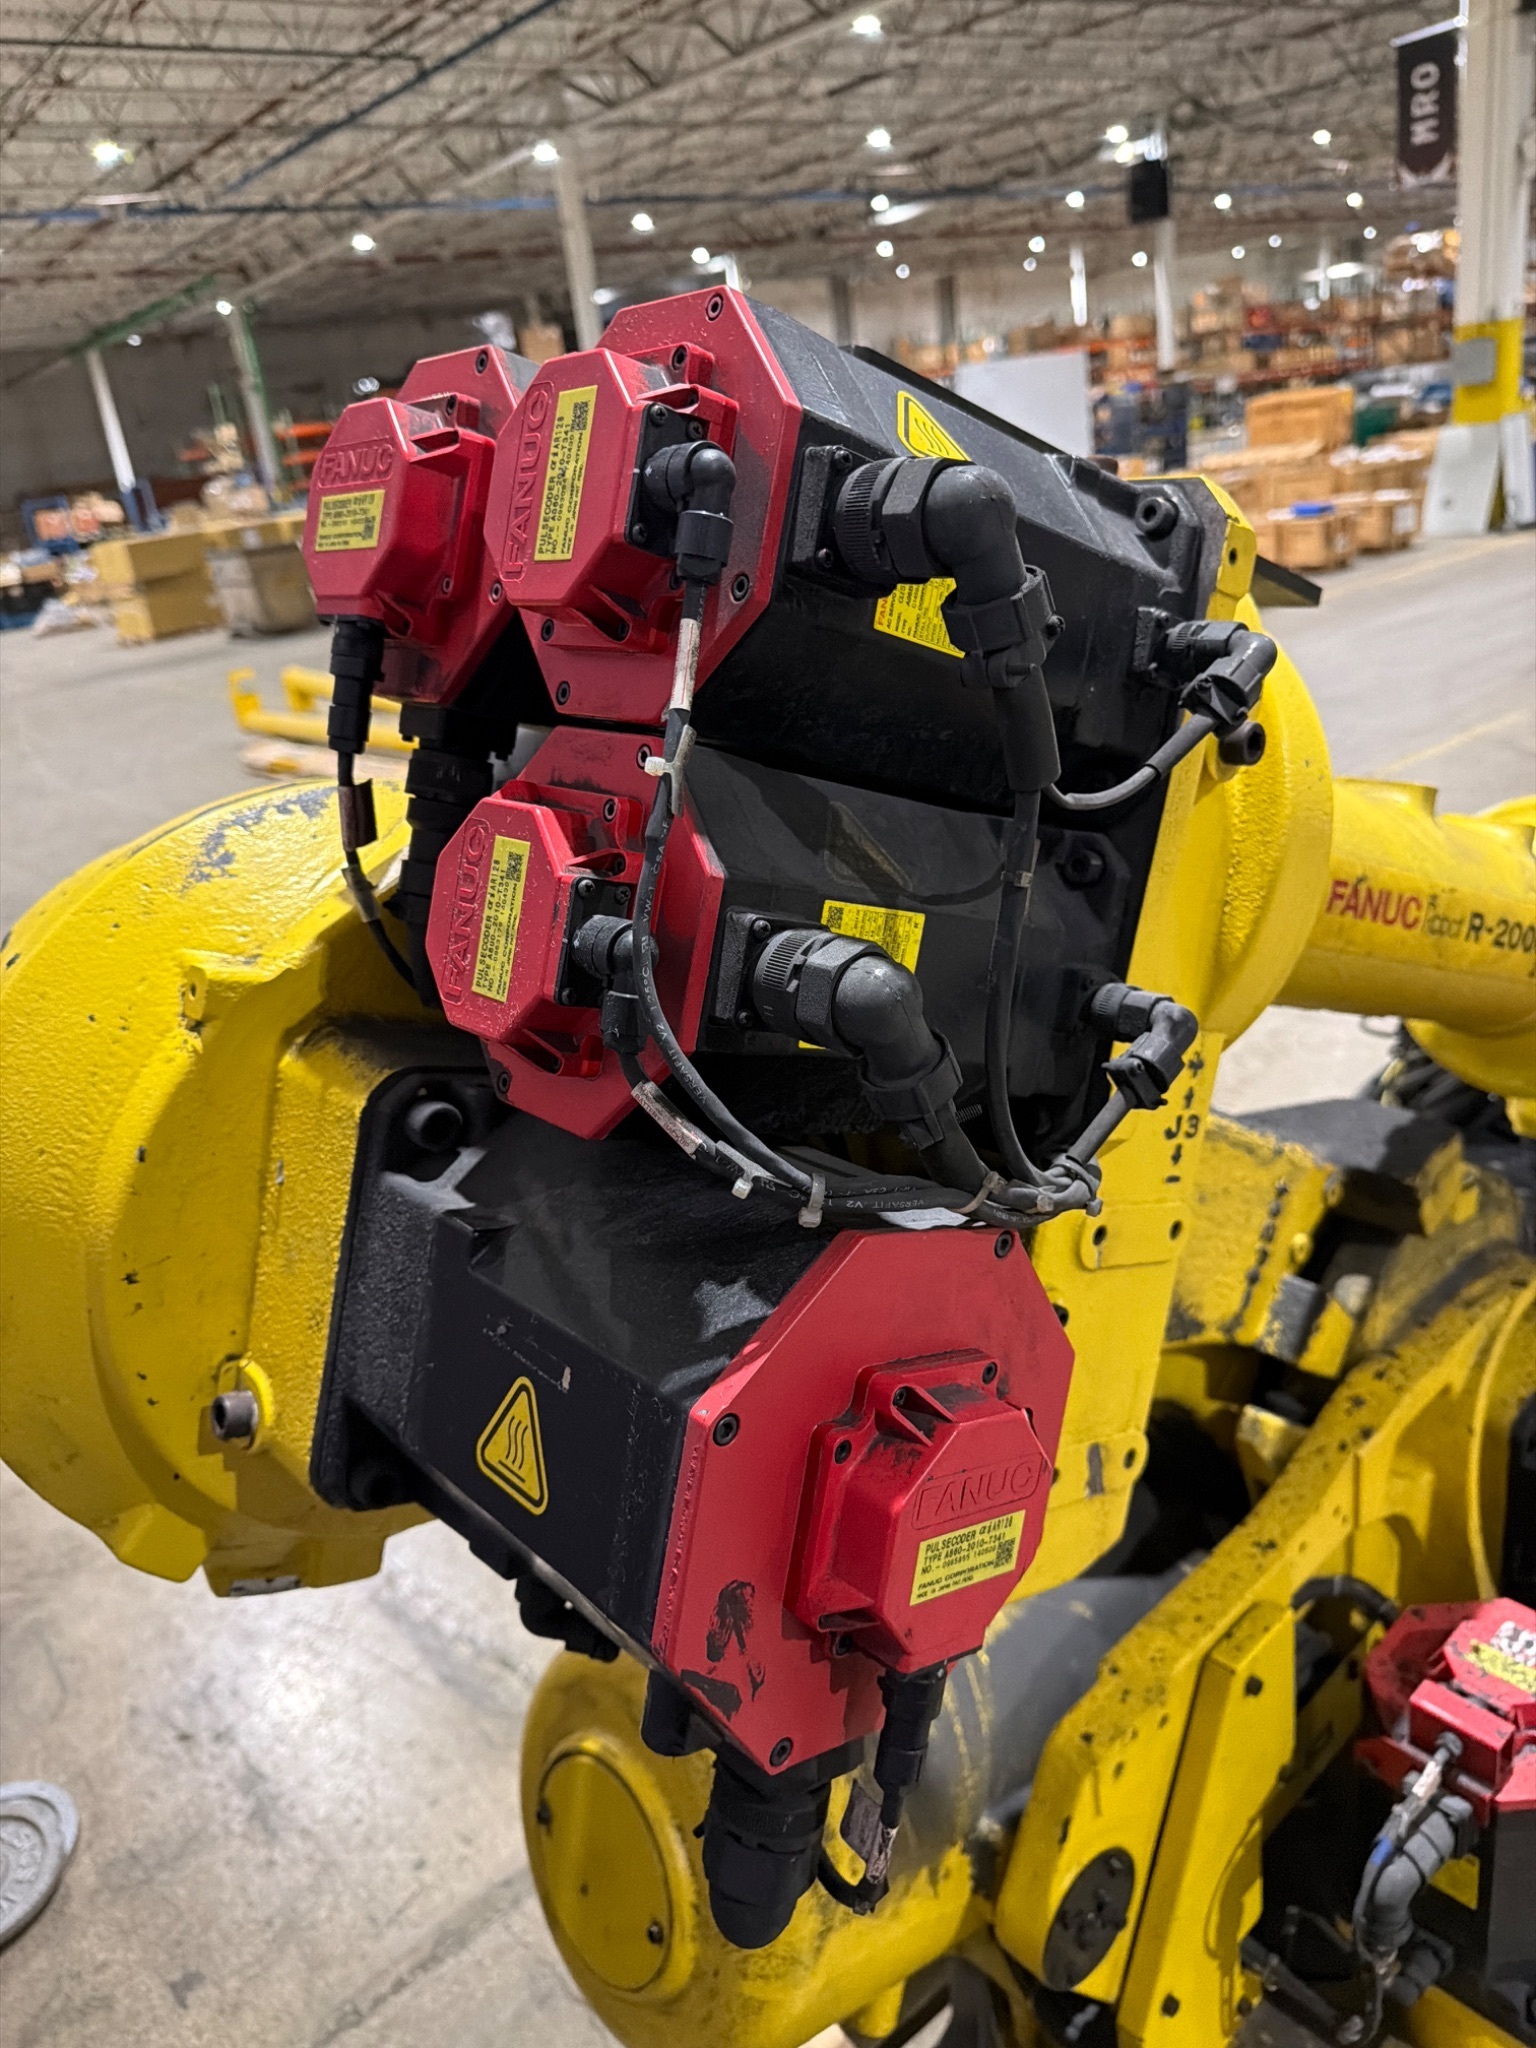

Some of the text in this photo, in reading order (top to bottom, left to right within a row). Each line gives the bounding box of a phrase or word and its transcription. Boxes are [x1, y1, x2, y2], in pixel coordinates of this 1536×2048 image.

[1410, 61, 1440, 145] MRO
[321, 443, 393, 485] FANUC
[505, 389, 548, 576] FANUC
[537, 476, 556, 553] PULSECODER
[560, 432, 583, 553] FANUC CORPORATION
[545, 526, 554, 553] TYPE
[448, 826, 485, 999] FANUC
[1326, 879, 1422, 930] FANUC
[1464, 912, 1536, 953] R-200
[475, 914, 492, 987] PULSECODER
[495, 882, 517, 995] FANUC CORPORATION
[482, 963, 490, 989] TYPE
[1164, 1113, 1199, 1140] J3
[846, 1199, 864, 1209] V2
[873, 1199, 924, 1210] VERSAFIT
[916, 1460, 1034, 1521] FANUC
[923, 1551, 942, 1565] TYPE
[925, 1528, 976, 1555] PULSECODER
[917, 1558, 994, 1590] FANUC CORPORATION
